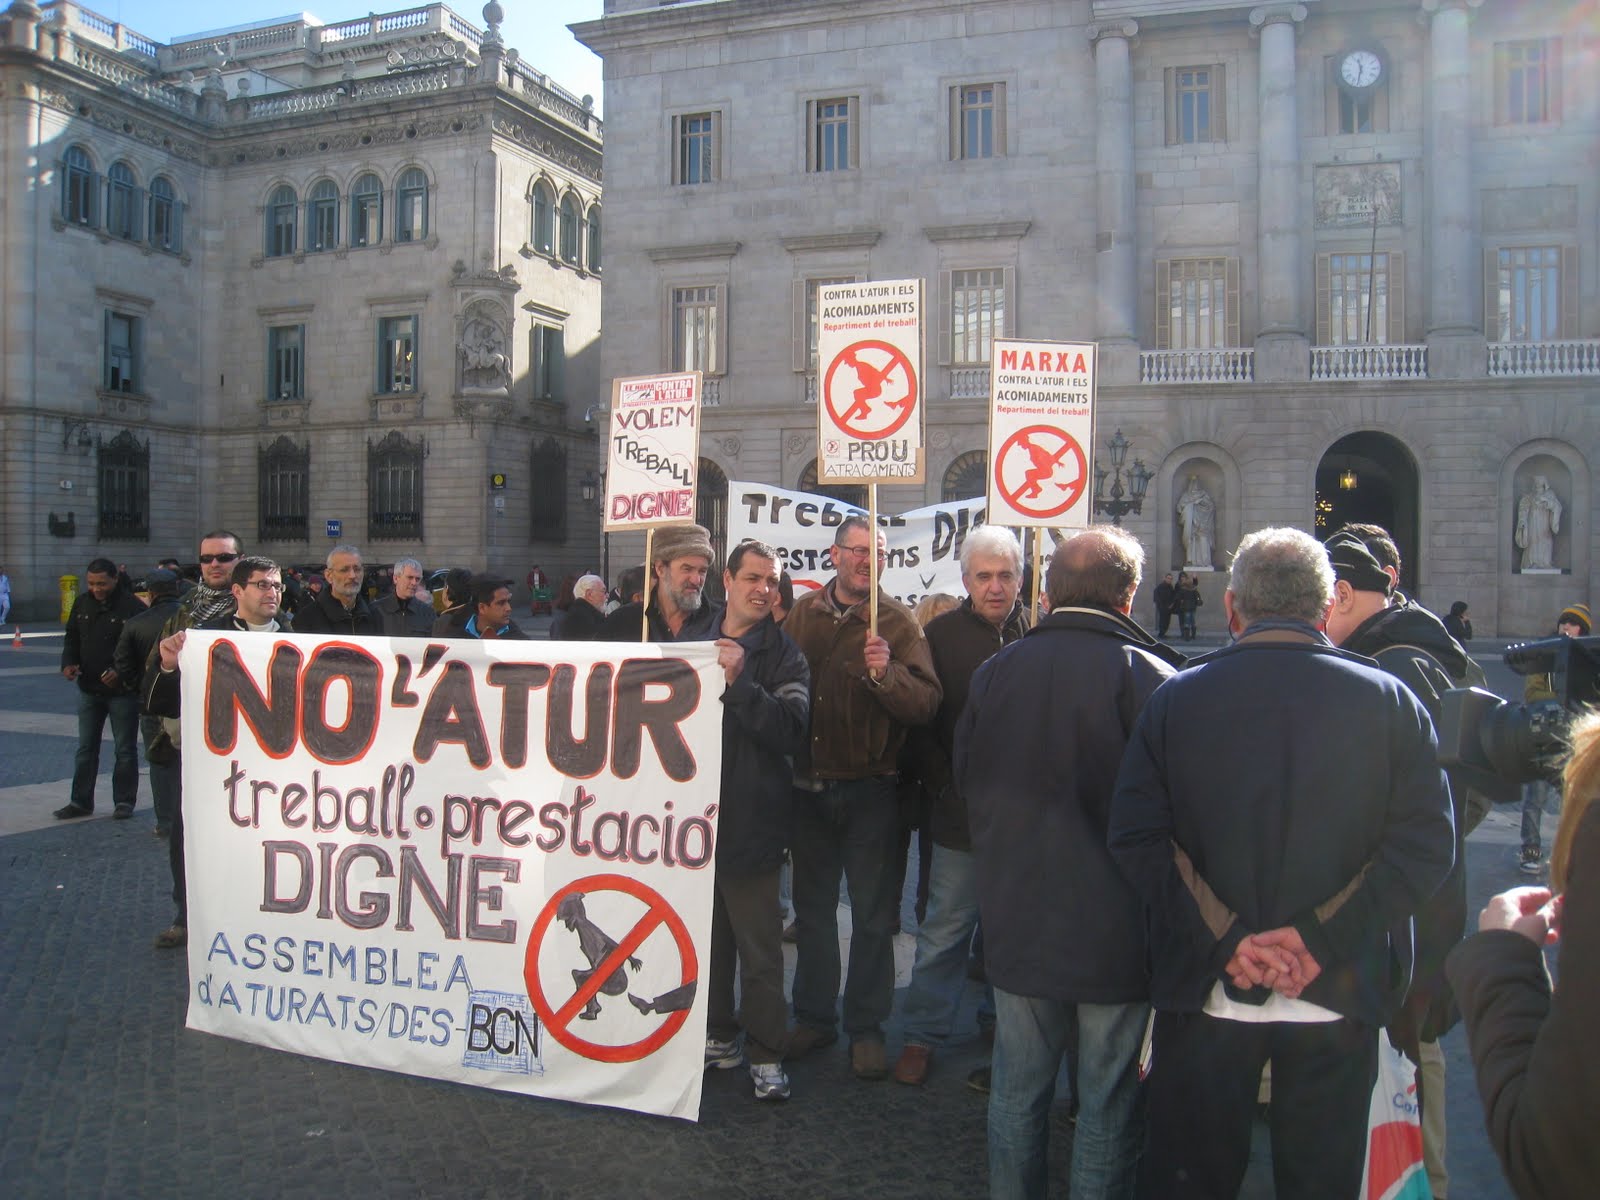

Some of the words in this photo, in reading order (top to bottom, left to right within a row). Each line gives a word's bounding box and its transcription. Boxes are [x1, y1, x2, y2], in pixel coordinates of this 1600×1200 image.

[824, 289, 857, 300] CONTRA
[860, 286, 890, 298] L'ATUR
[892, 286, 896, 296] I
[898, 285, 914, 296] ELS
[823, 301, 915, 318] ACOMIADAMENTS
[823, 321, 871, 332] Repartiment
[873, 319, 885, 328] del
[887, 317, 917, 328] treball!
[1001, 350, 1087, 373] MARXA
[655, 379, 692, 391] CONTRA
[998, 375, 1032, 385] CONTRA
[1035, 376, 1064, 386] L'ATUR
[1067, 377, 1070, 386] I
[1073, 378, 1088, 387] ELS
[658, 388, 688, 400] L'ATUR
[997, 390, 1088, 404] ACOMIADAMENTS
[615, 405, 695, 431] VOLEM
[997, 404, 1045, 415] Repartiment
[1047, 406, 1059, 415] del
[1061, 408, 1090, 417] treball!
[613, 435, 693, 486] TREBALL
[847, 439, 908, 462] PROU
[824, 463, 917, 478] ATRACAMENTS
[611, 489, 694, 521] DIGNE
[204, 637, 383, 765] NO
[391, 644, 702, 782] L'ATUR
[223, 760, 415, 840] treball
[441, 785, 719, 870] prestació
[259, 840, 521, 943] DIGNE
[207, 931, 475, 994] ASSEMBLEA
